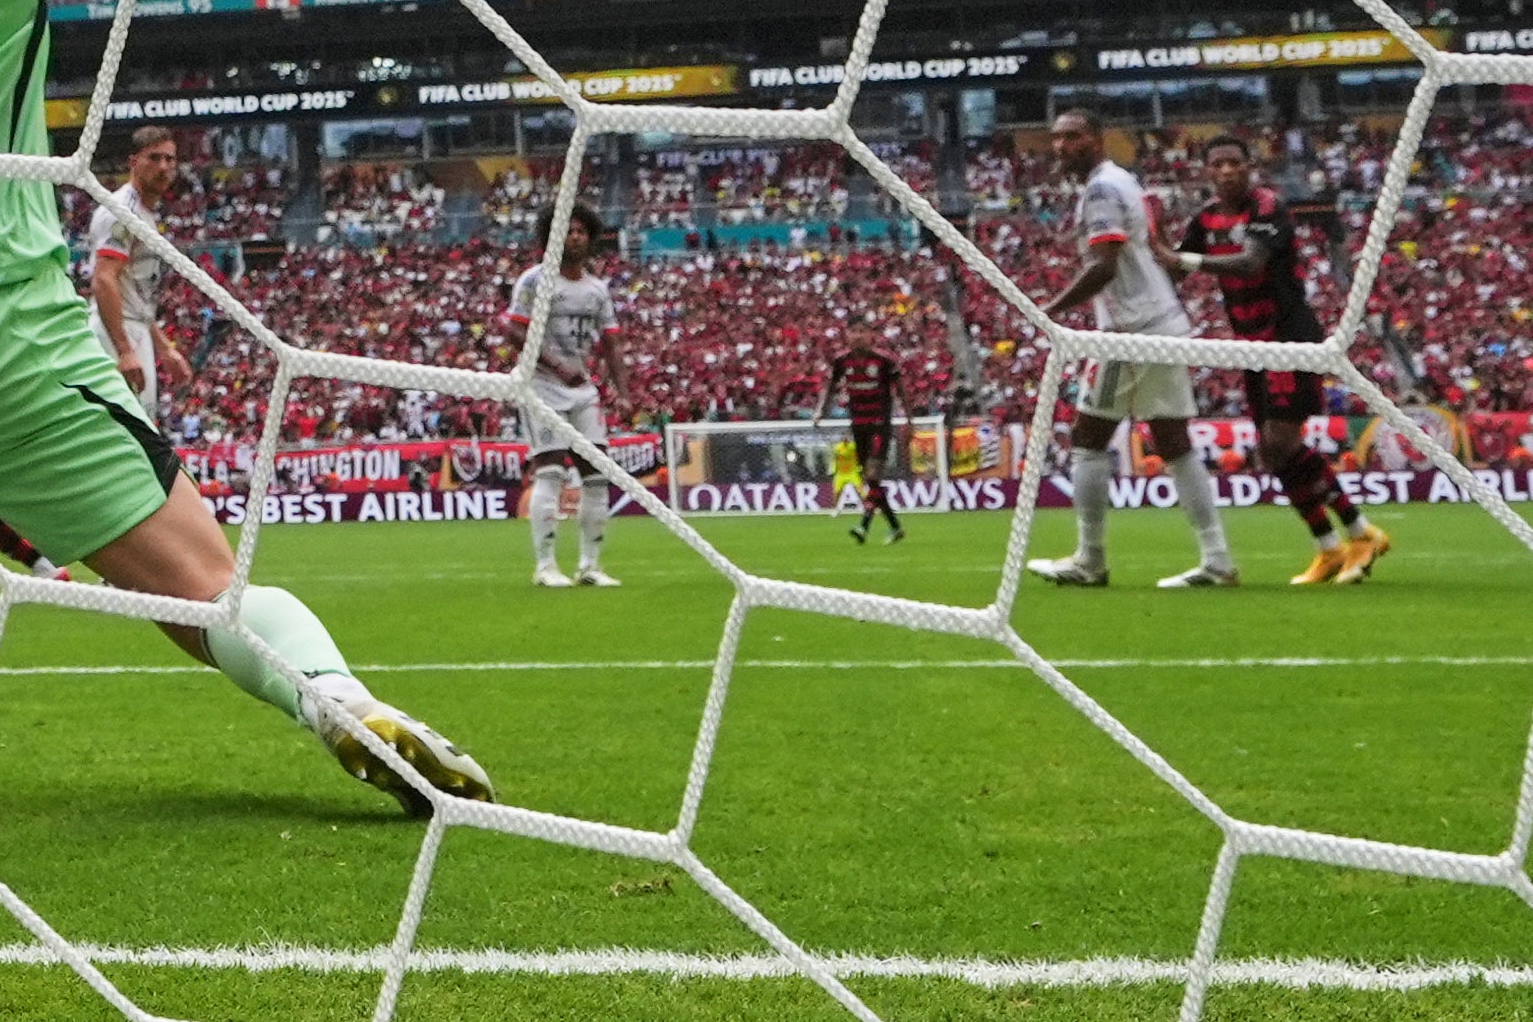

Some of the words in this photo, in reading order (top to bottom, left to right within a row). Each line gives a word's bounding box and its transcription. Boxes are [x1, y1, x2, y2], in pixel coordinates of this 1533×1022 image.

[1097, 49, 1145, 70] FIFA
[1145, 46, 1201, 67] CLUB
[1201, 42, 1280, 65] WORLD
[1281, 40, 1326, 61] CUP
[1465, 29, 1517, 52] FIFA
[749, 67, 794, 87] FIFA
[794, 65, 845, 86] CLUB
[861, 60, 923, 82] ORLD
[923, 58, 966, 79] CUP
[418, 84, 460, 105] FIFA
[461, 82, 511, 101] CLUB
[512, 79, 582, 99] WOD
[583, 76, 624, 96] CUP
[105, 100, 144, 120] FIFA
[144, 99, 193, 118] CLUB
[192, 95, 260, 116] WORLD
[260, 94, 299, 112] CUP
[687, 481, 820, 512] QATAR
[837, 477, 1007, 511] ARWAYS
[1108, 474, 1292, 509] WOLD'
[1335, 471, 1415, 504] EST
[261, 492, 350, 524] BEST
[357, 489, 509, 521] AIRLINE
